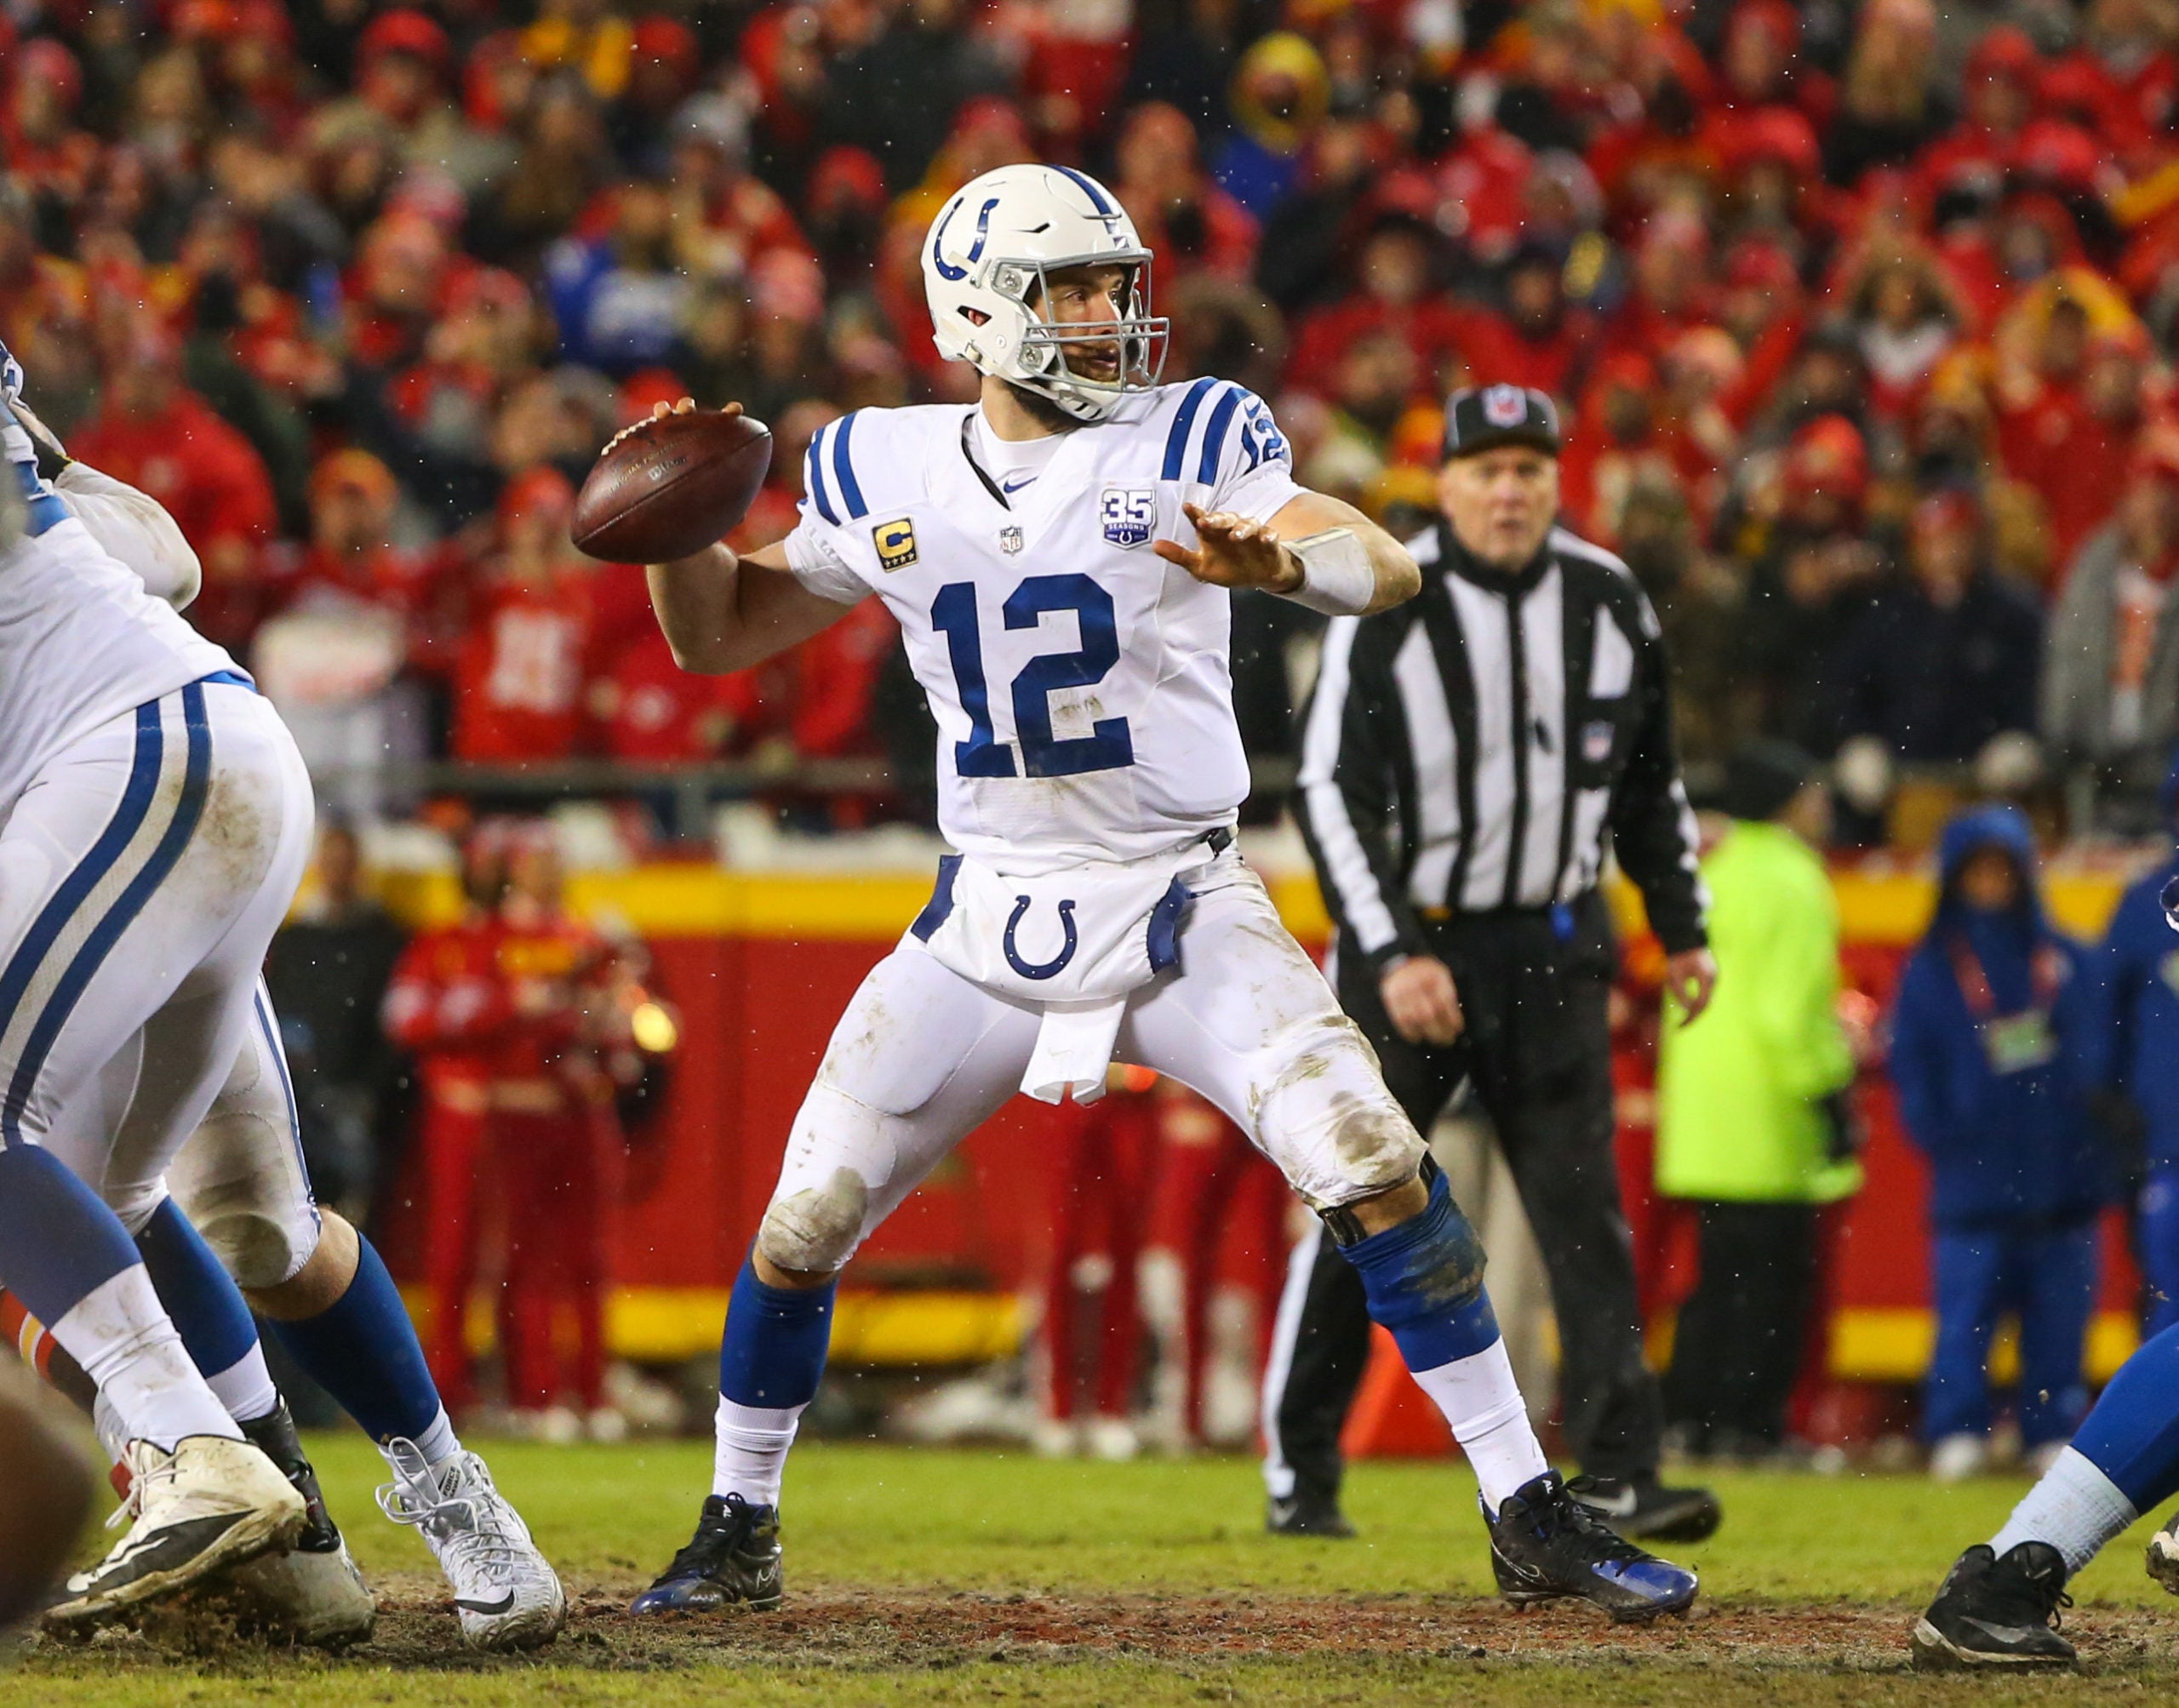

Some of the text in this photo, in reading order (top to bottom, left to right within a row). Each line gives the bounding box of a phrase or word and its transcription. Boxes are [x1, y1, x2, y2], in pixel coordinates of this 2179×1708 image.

[1241, 418, 1284, 476] 12
[1101, 489, 1154, 525] 35
[876, 520, 913, 558] C
[1108, 523, 1145, 531] SEASONS
[930, 572, 1135, 778] 12
[443, 1465, 455, 1496] FORCE
